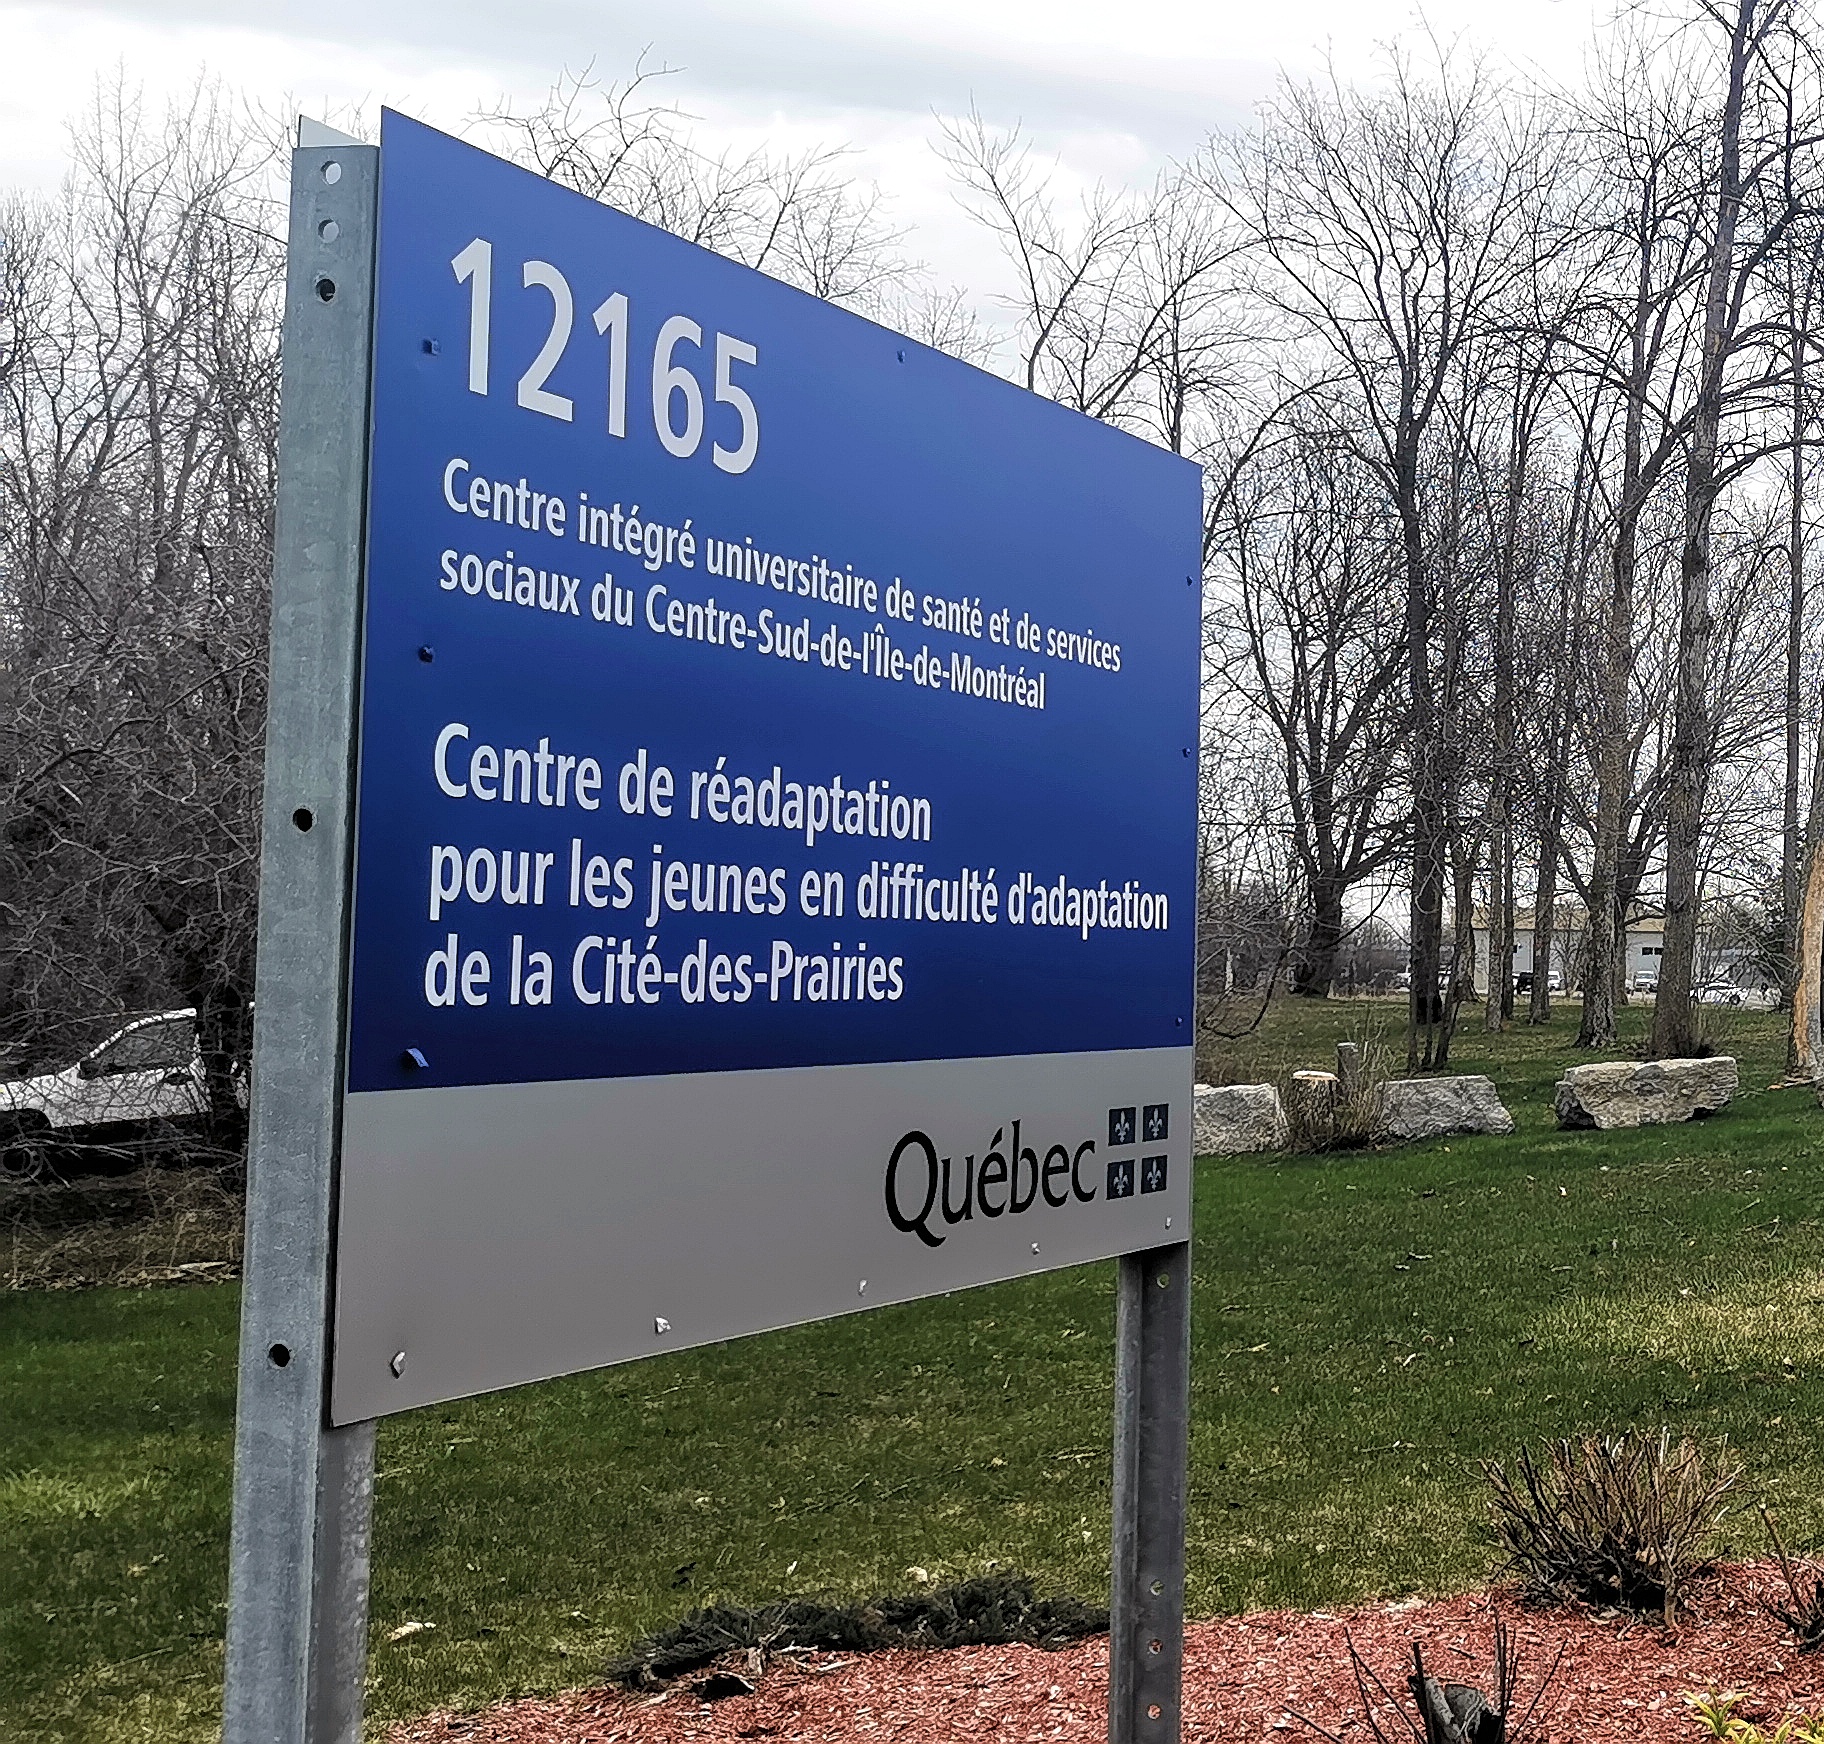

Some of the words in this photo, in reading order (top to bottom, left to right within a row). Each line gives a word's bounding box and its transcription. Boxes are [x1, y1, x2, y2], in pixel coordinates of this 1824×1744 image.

[450, 236, 760, 475] 12165
[443, 457, 566, 537] Centre
[578, 491, 696, 573] intégré
[707, 536, 879, 614] universitaire
[885, 577, 916, 622] de
[922, 595, 983, 639] santé
[989, 608, 1011, 646] et
[1016, 612, 1042, 653] de
[1046, 626, 1121, 673] services
[440, 549, 581, 616] sociaux
[591, 572, 634, 627] du
[645, 584, 1045, 710] Centre-Sud-de-l'Île-de-Montréal
[434, 722, 602, 811] Centre
[618, 748, 674, 818] de
[690, 756, 931, 847] réadaptation
[430, 845, 554, 921] pour
[569, 837, 634, 909] les
[645, 843, 786, 928] jeunes
[799, 870, 844, 917] en
[857, 860, 999, 924] difficulté
[1007, 871, 1168, 941] d'adaptation
[424, 932, 491, 1007] de
[510, 934, 553, 1006] la
[572, 934, 904, 1005] Cité-des-Prairies
[885, 1119, 1098, 1247] Québec
